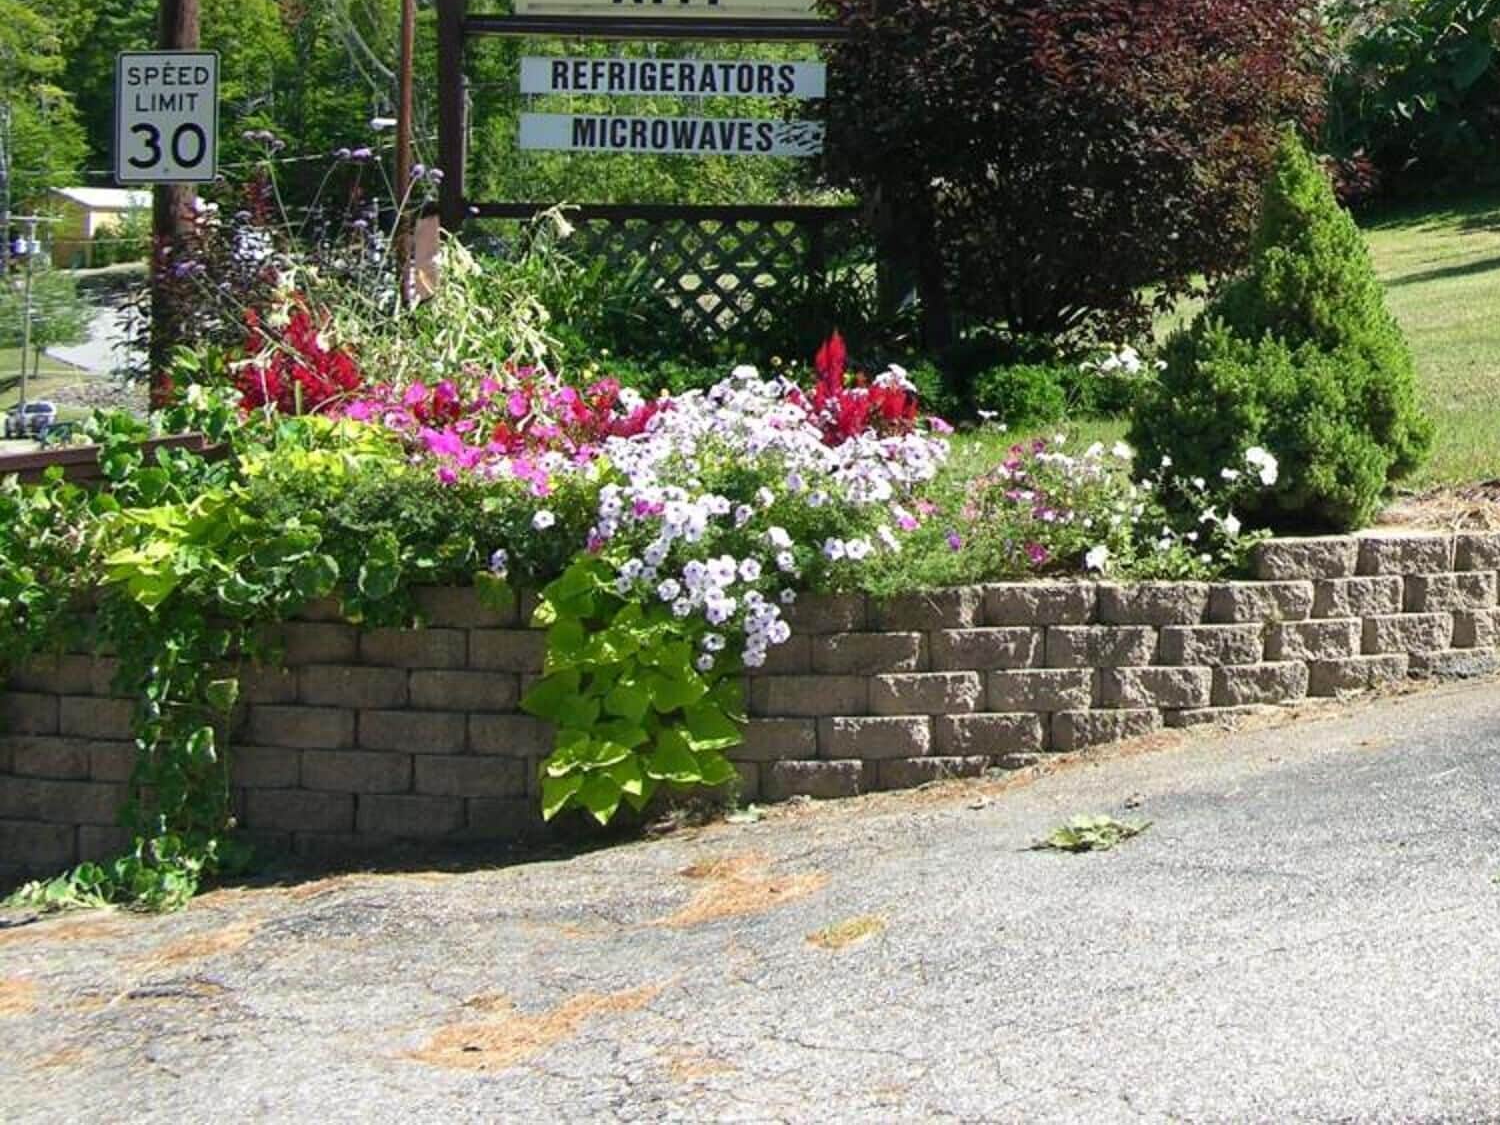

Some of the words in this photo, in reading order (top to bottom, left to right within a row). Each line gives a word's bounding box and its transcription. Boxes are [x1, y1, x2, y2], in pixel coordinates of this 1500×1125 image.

[127, 66, 209, 86] SPEED
[551, 60, 795, 93] REFRIGERATORS
[135, 93, 199, 112] LIMIT
[128, 122, 207, 169] 30
[571, 117, 774, 152] MICROWAVES
